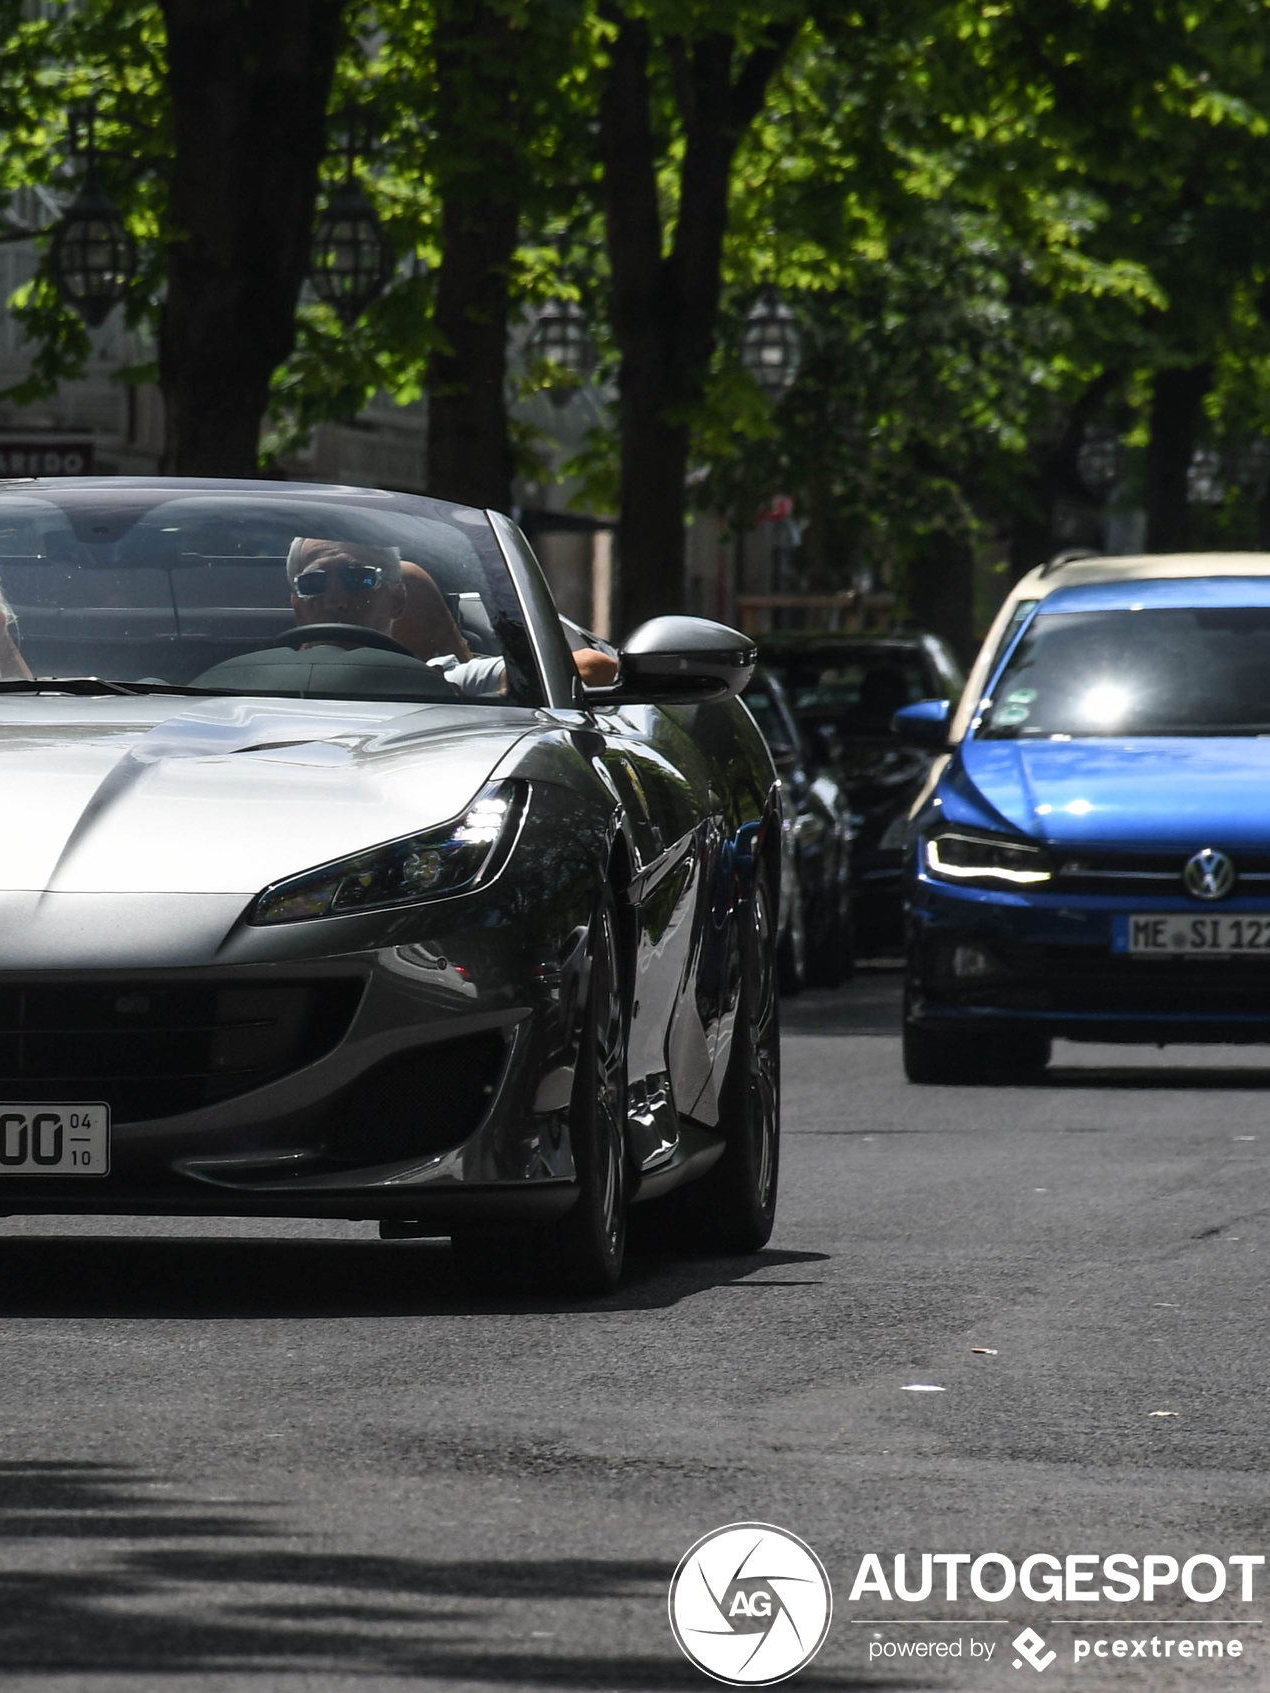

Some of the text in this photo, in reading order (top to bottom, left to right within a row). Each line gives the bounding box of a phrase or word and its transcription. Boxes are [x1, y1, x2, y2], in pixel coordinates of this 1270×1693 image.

[1133, 919, 1167, 948] ME
[1190, 919, 1220, 948] SI
[69, 1113, 91, 1129] 04
[71, 1150, 91, 1166] 10
